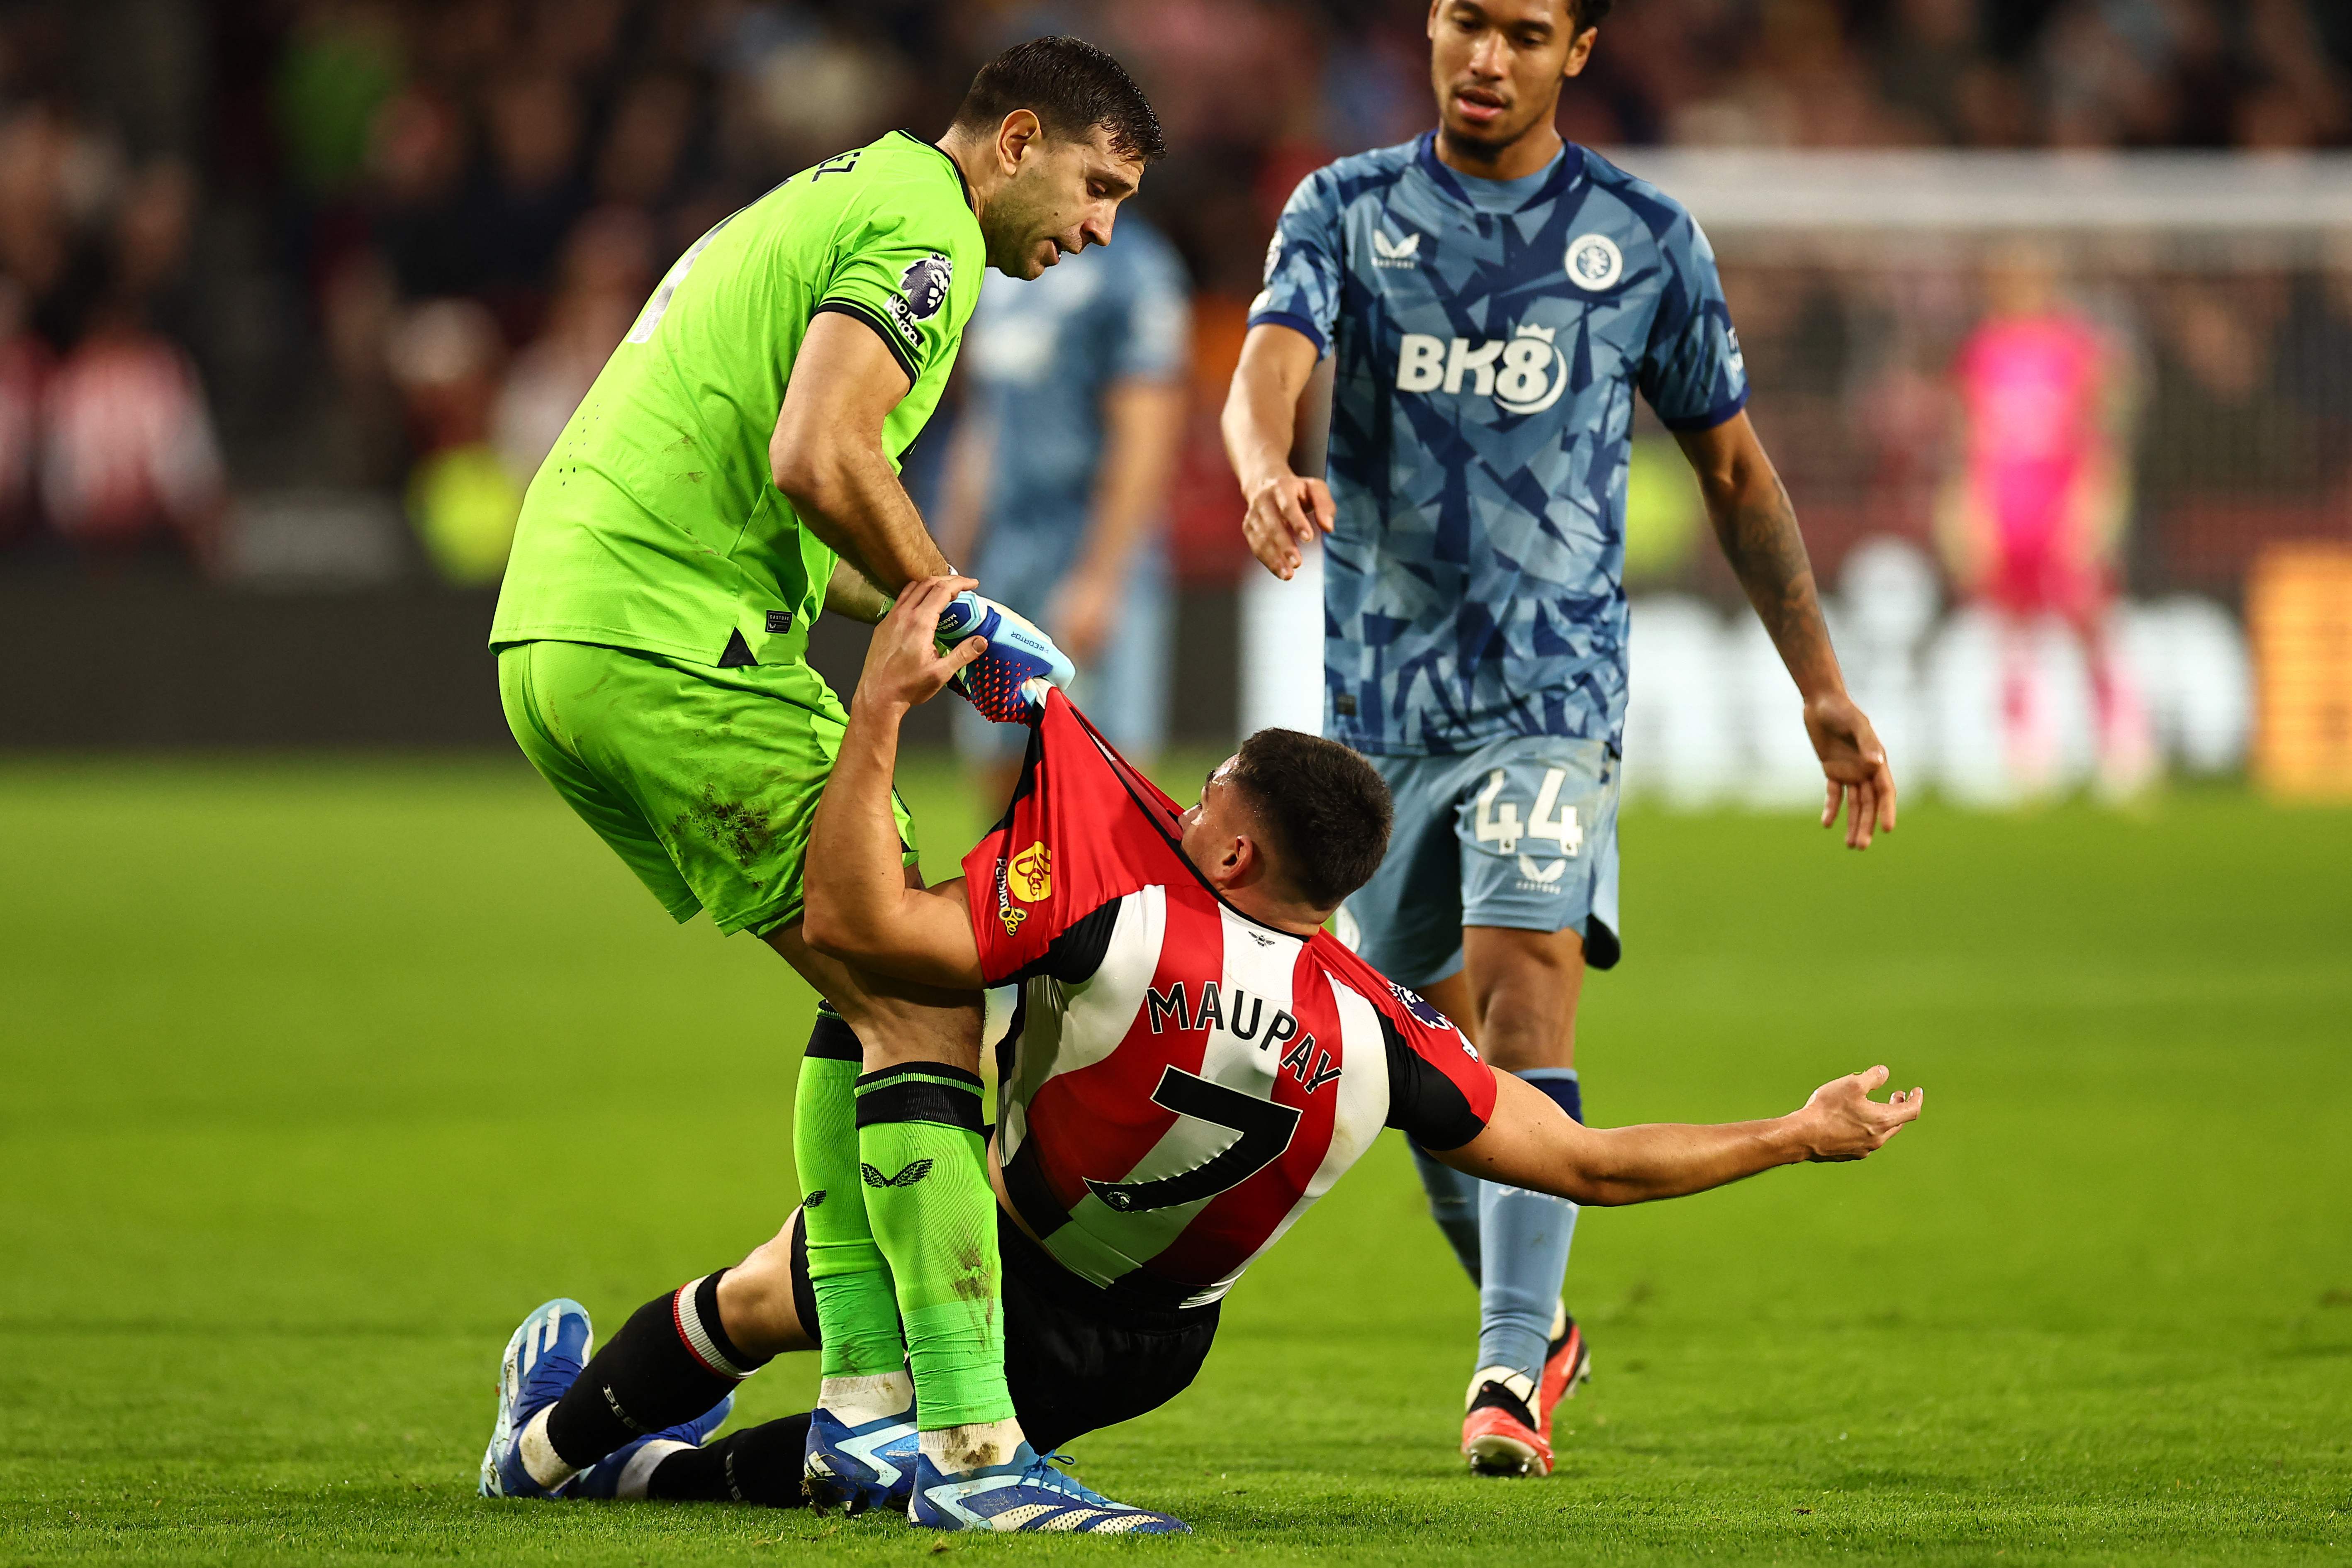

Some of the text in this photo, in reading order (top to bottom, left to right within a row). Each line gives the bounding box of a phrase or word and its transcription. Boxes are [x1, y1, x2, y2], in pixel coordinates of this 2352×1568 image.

[890, 293, 908, 314] No
[1396, 333, 1560, 409] BK8
[1011, 631, 1049, 654] PREDATOR
[1475, 767, 1583, 857] 44
[1145, 980, 1344, 1095] MAUPAY
[1082, 1064, 1303, 1214] 7
